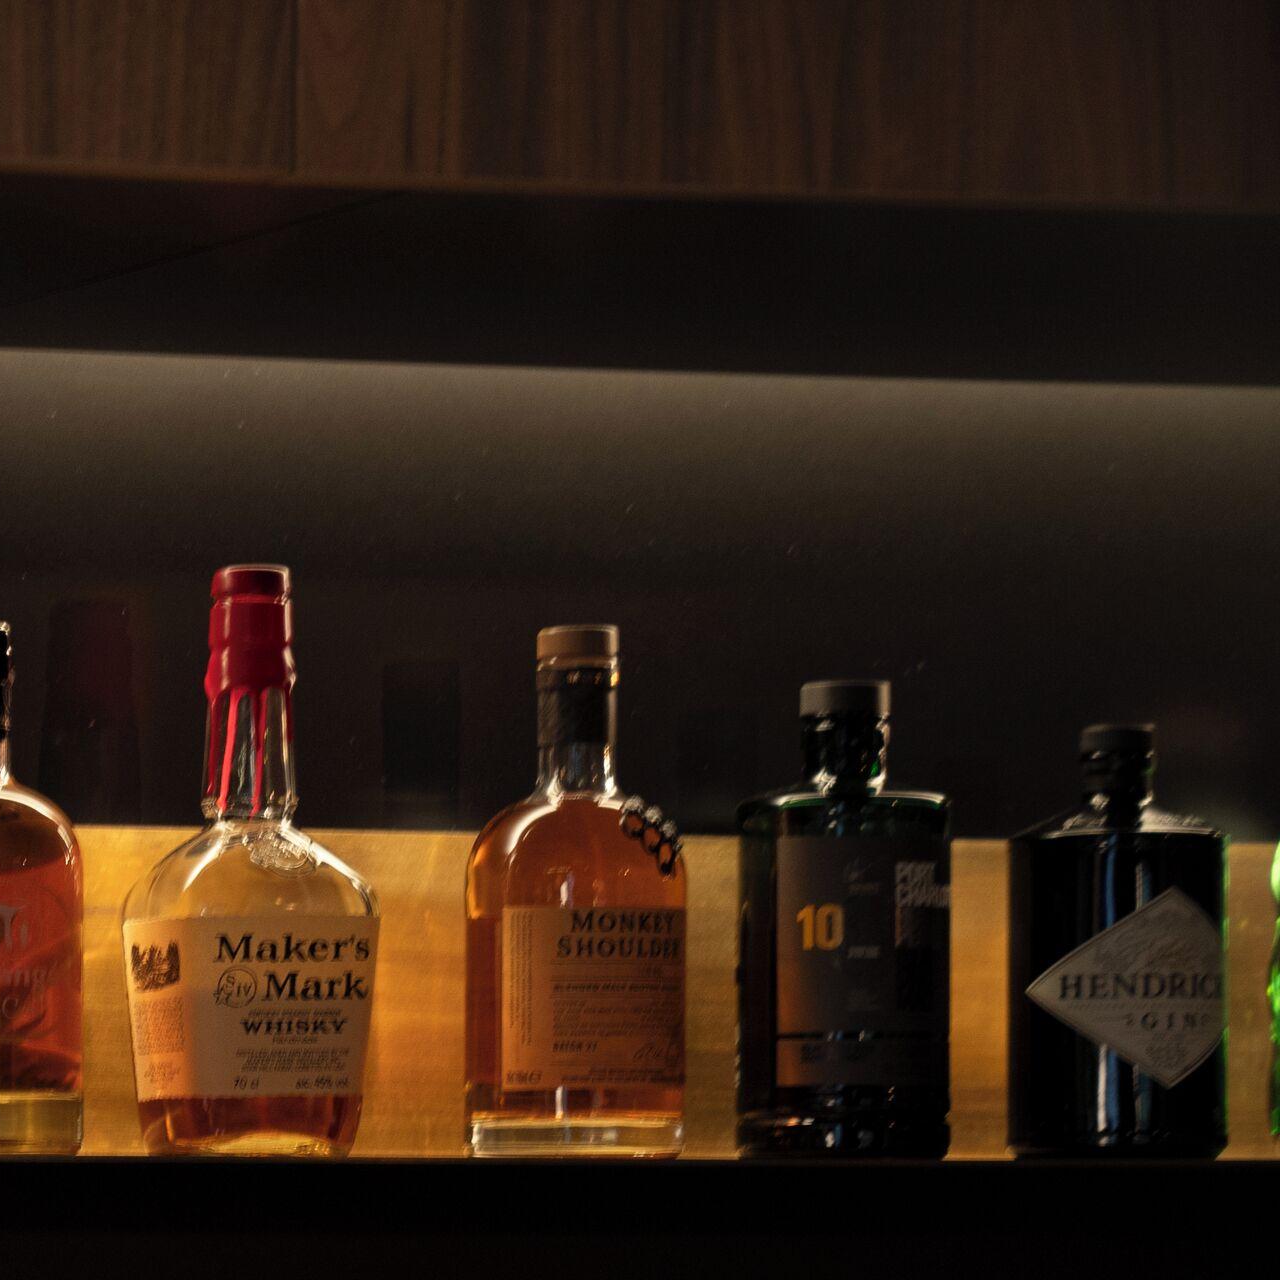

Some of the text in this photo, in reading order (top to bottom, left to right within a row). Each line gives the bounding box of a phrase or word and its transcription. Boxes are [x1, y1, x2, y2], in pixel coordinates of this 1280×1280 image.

[571, 911, 675, 934] MONKEY
[796, 902, 846, 951] 10
[213, 931, 370, 963] Maker's
[262, 970, 368, 1003] Mark
[239, 1017, 348, 1035] WHISKY
[1140, 1012, 1198, 1030] GIN
